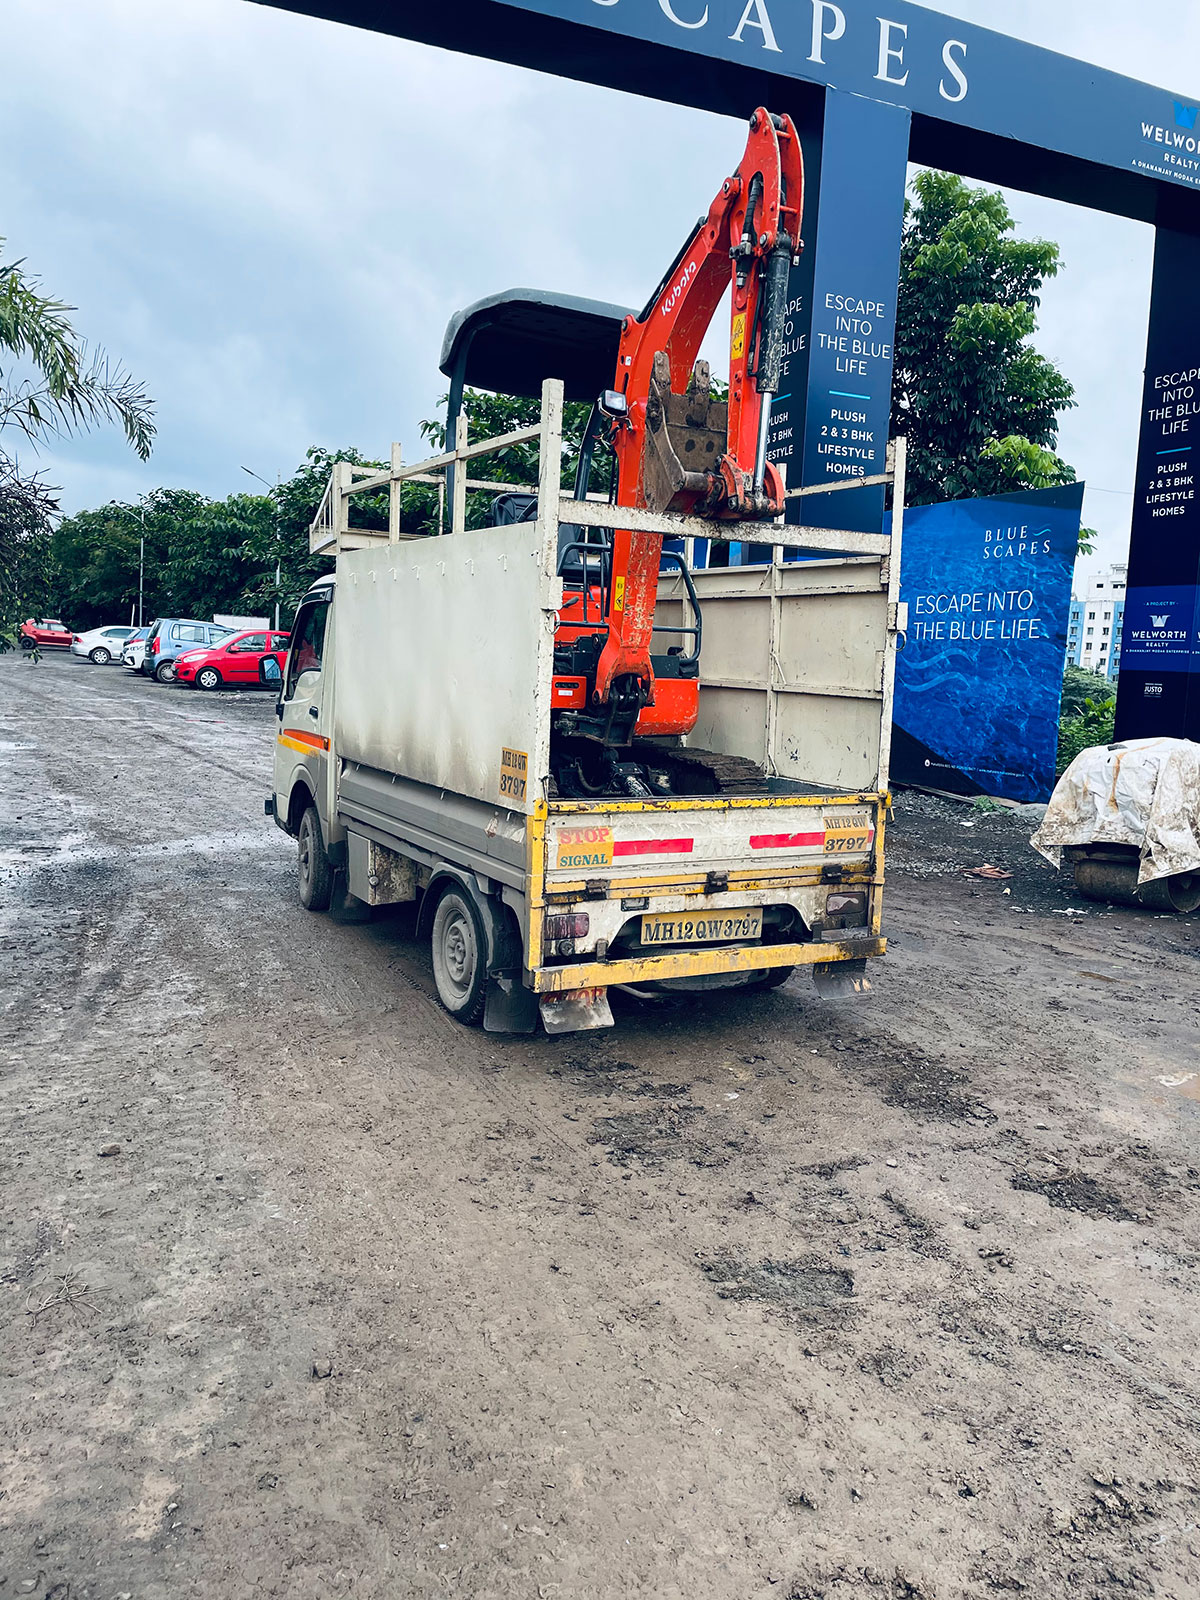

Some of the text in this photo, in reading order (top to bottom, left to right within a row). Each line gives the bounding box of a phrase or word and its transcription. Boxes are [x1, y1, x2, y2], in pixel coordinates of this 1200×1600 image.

[591, 0, 969, 102] APES
[1164, 153, 1200, 171] REALTY
[1173, 172, 1194, 183] MODAK
[661, 261, 697, 316] Kubota
[783, 296, 803, 317] APE
[825, 293, 885, 318] ESCAPE
[836, 316, 872, 336] INTO
[818, 333, 891, 359] THE BLUE
[835, 357, 868, 376] LIFE
[1162, 386, 1194, 403] INTO
[769, 411, 789, 427] LUSH
[831, 408, 866, 423] PLUSH
[1148, 406, 1173, 422] THE
[772, 432, 776, 443] 3
[778, 427, 793, 441] BHK
[820, 426, 874, 442] 2 & 3 BHK
[1162, 419, 1190, 435] LIFE
[765, 444, 794, 461] ESTYLE
[817, 443, 875, 460] LIFESTYLE
[826, 462, 865, 476] HOMES
[1157, 462, 1188, 474] PLUSH
[1148, 476, 1194, 490] 2 & 3 BHK
[1146, 490, 1194, 504] LIFESTYLE
[1152, 506, 1185, 518] HOMES
[984, 525, 1028, 543] BLUE
[982, 540, 1051, 560] SCAPES
[915, 590, 1033, 615] ESCAPE INTO
[914, 618, 1042, 640] THE BLUE LIFE
[1131, 630, 1187, 639] WELWORTH
[502, 750, 511, 767] MH
[500, 774, 526, 798] 3797
[825, 816, 866, 830] MH 12 QW
[560, 828, 610, 844] STOP
[825, 837, 867, 851] 3797
[560, 853, 608, 867] SIGNAL
[643, 918, 760, 942] MH12QW3797
